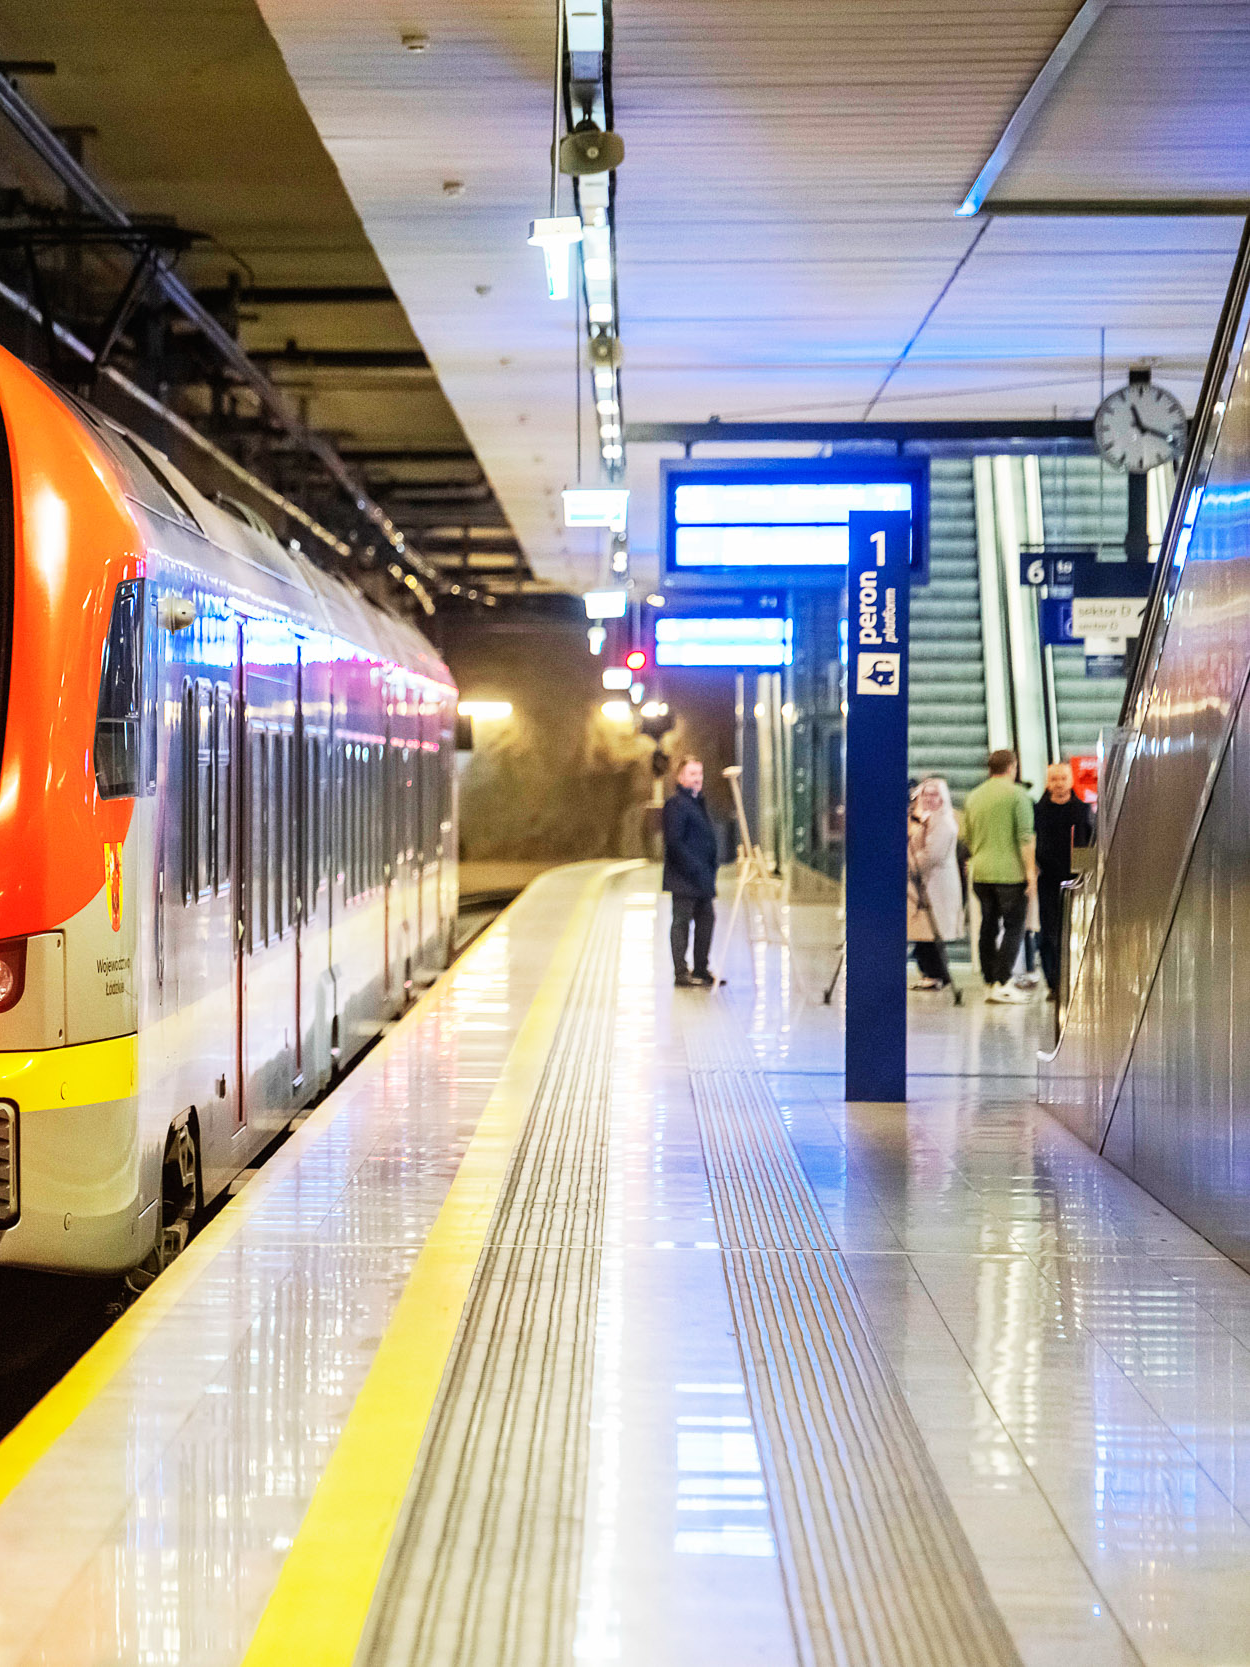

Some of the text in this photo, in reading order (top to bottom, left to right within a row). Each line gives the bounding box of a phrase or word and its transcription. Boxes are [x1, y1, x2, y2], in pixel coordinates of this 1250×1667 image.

[869, 530, 886, 567] 1
[1027, 559, 1045, 585] 6
[859, 570, 882, 645] peron
[882, 587, 899, 644] platform
